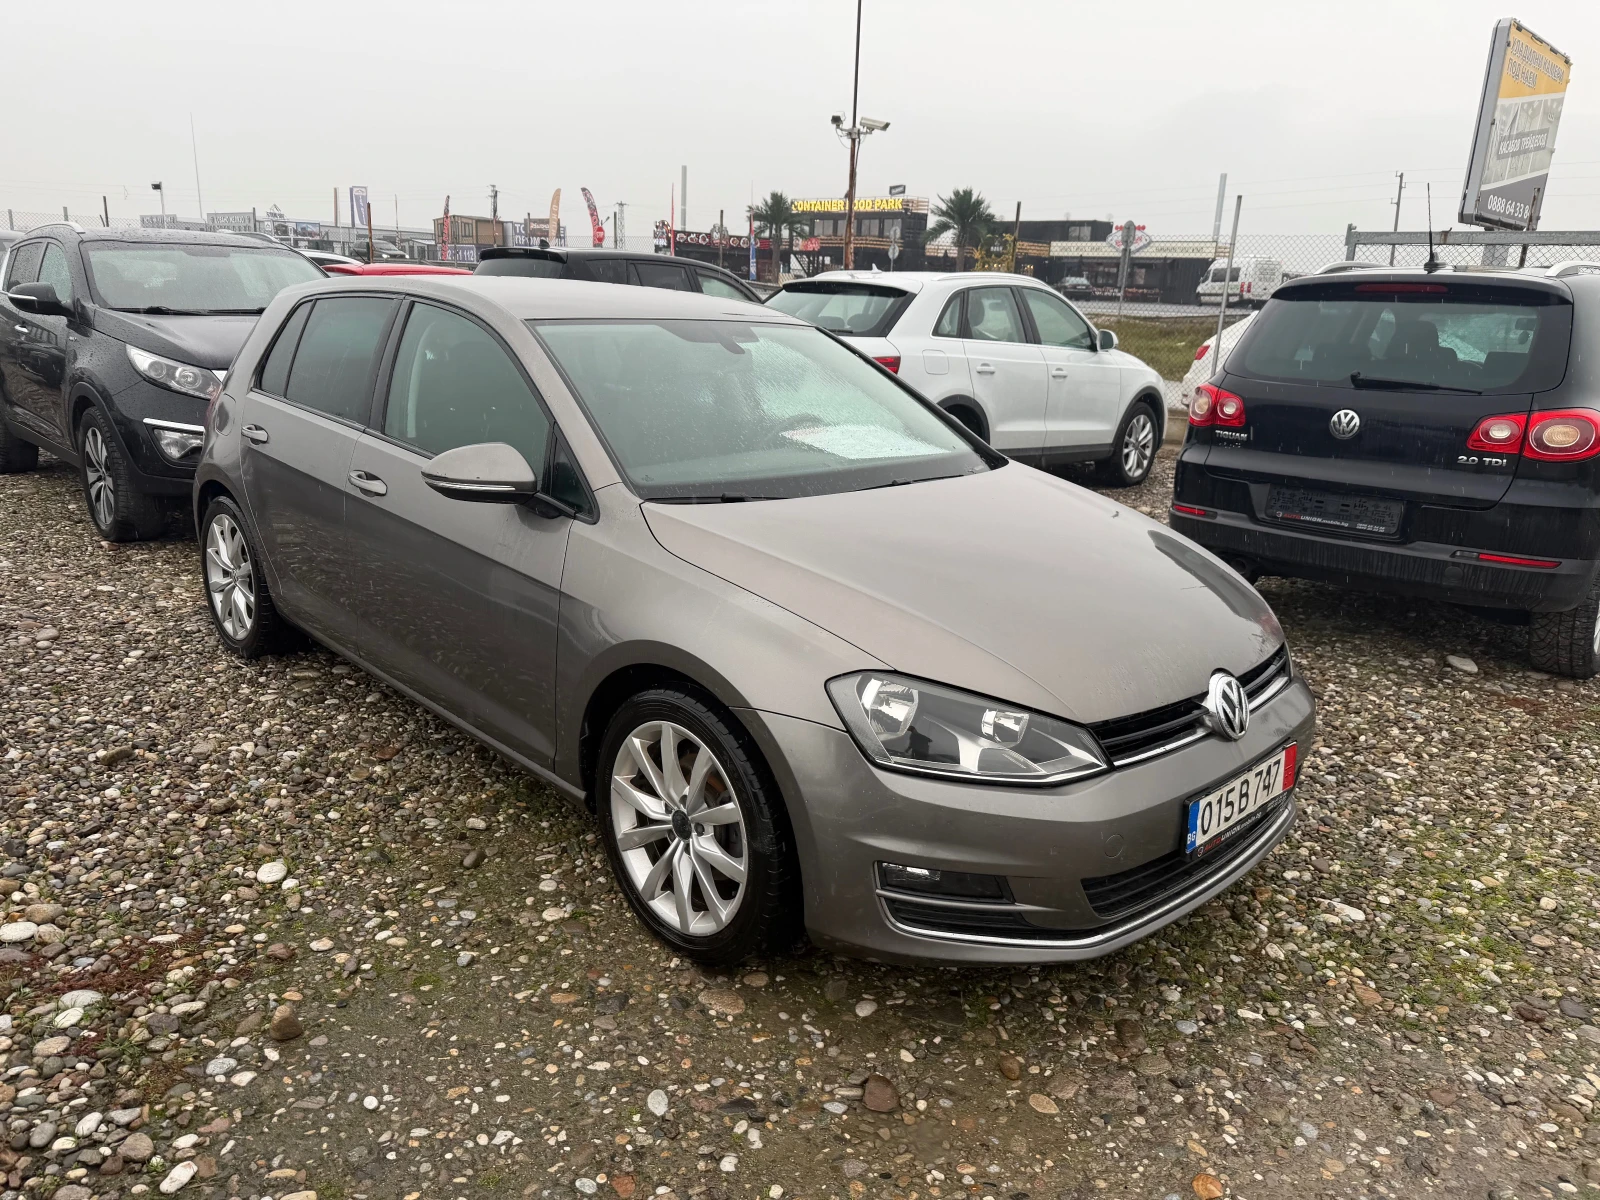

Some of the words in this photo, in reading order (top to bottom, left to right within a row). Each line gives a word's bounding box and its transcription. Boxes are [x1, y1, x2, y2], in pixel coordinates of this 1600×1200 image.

[792, 200, 844, 211] CONTAINER
[874, 198, 903, 210] PARK
[1487, 194, 1506, 213] 0888
[1505, 199, 1516, 216] 64
[1514, 202, 1525, 218] 33
[1523, 204, 1531, 220] 8
[1215, 429, 1248, 441] TIGUAN
[1482, 457, 1507, 467] TDI
[1186, 831, 1197, 845] BG
